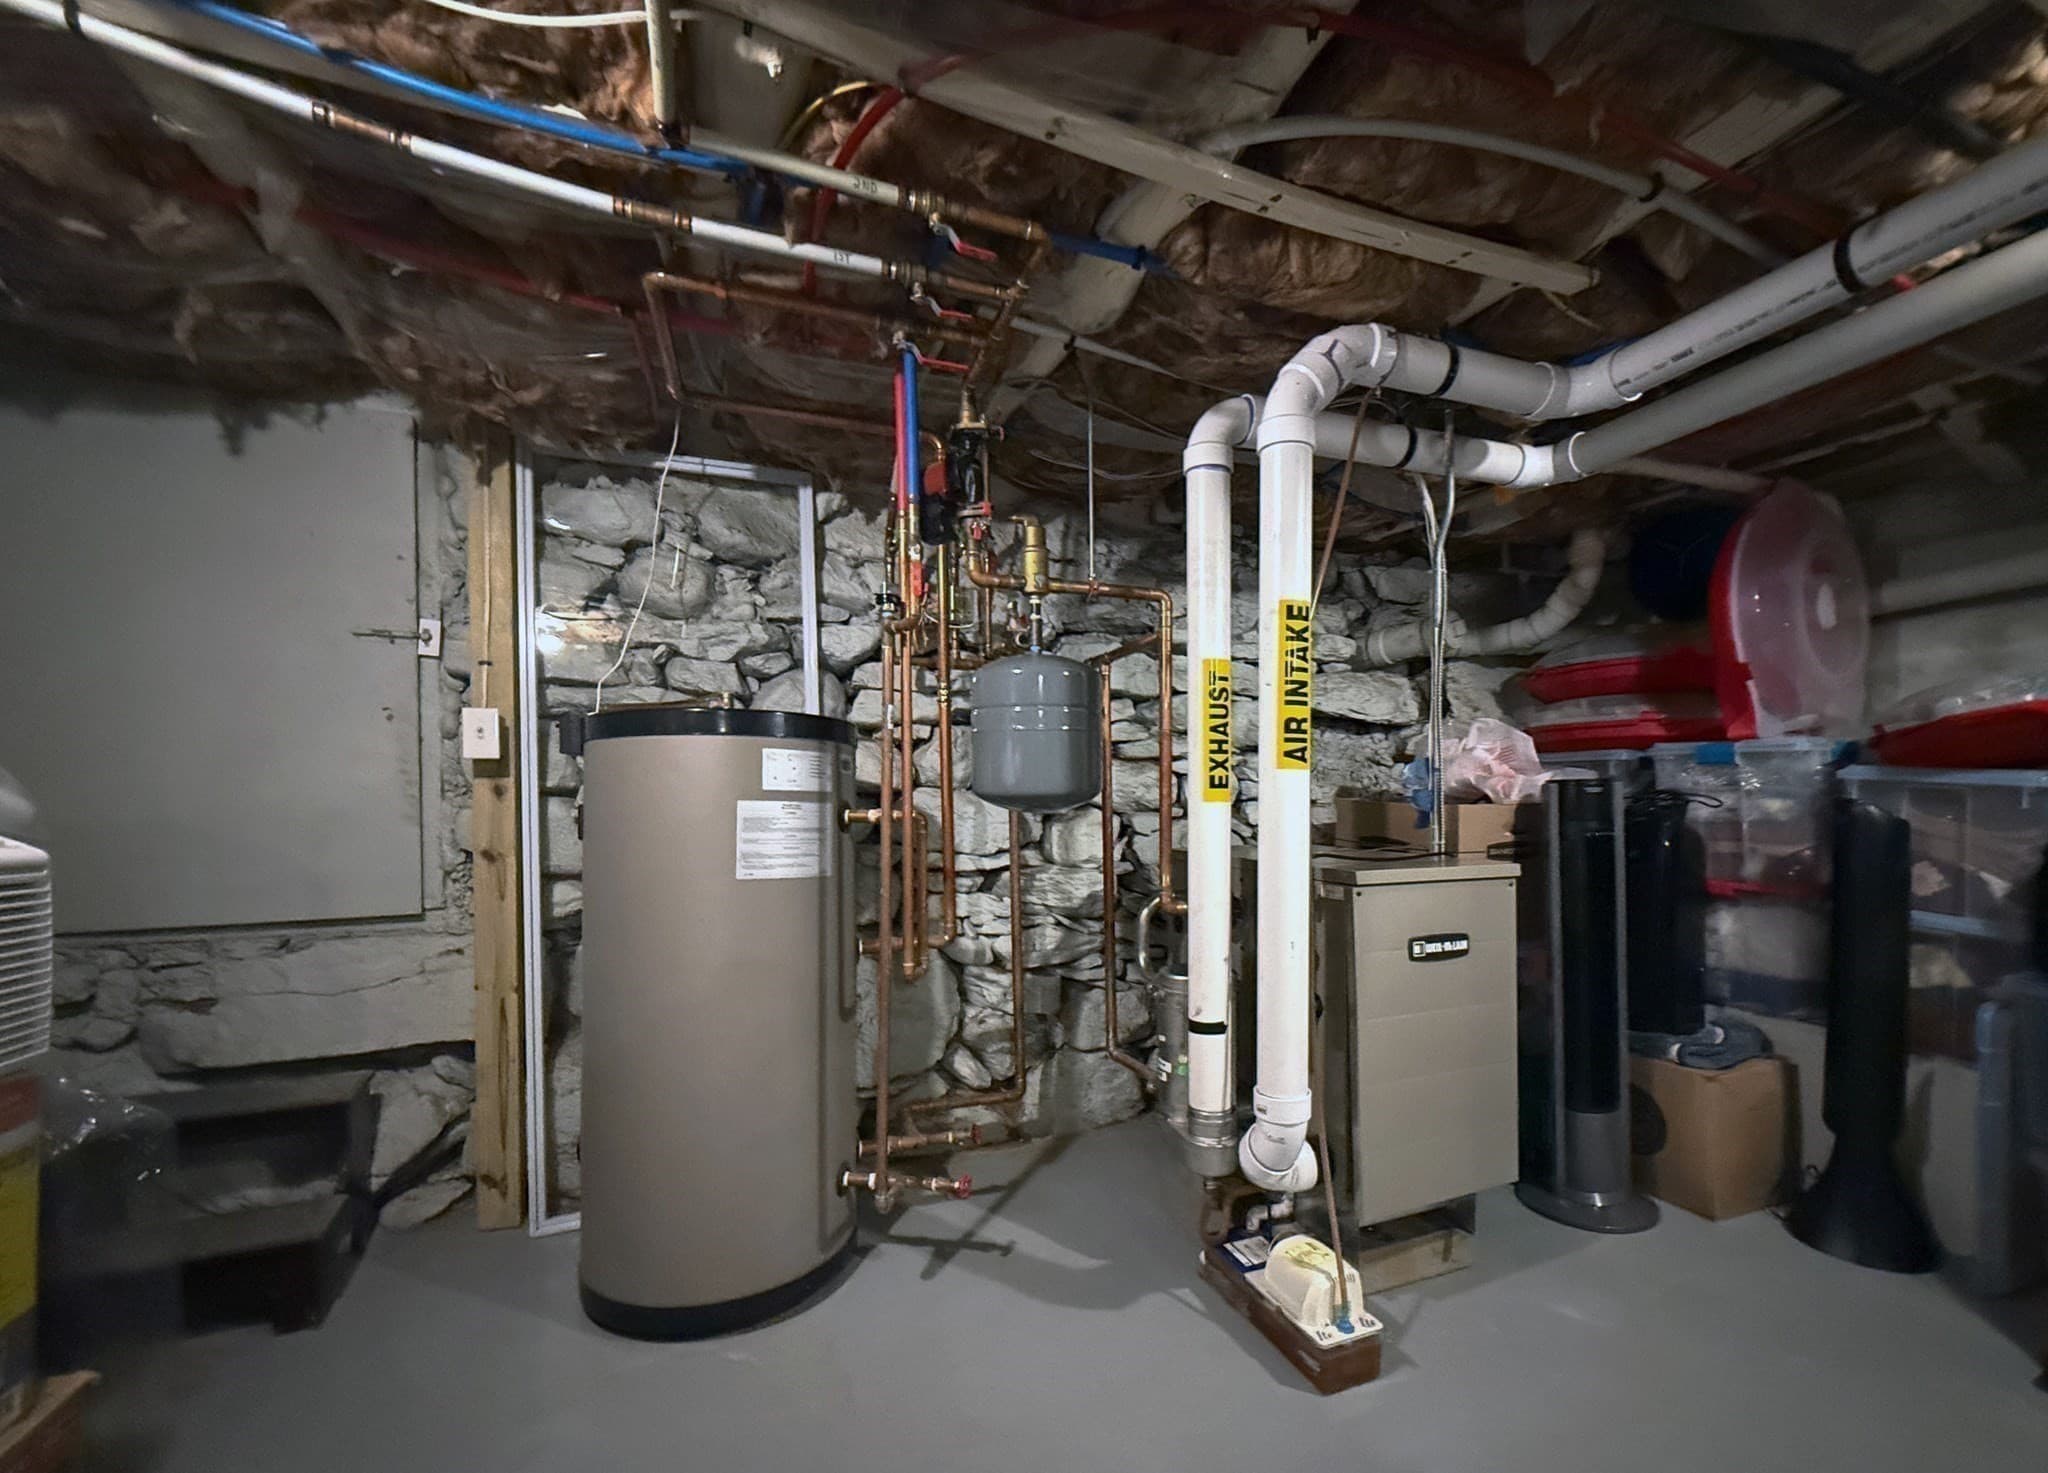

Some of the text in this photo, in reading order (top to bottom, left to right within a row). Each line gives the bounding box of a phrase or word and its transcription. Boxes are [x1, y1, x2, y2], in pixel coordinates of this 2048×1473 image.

[1208, 670, 1229, 789] EXHAUST
[1283, 604, 1310, 763] AIR INTAKE
